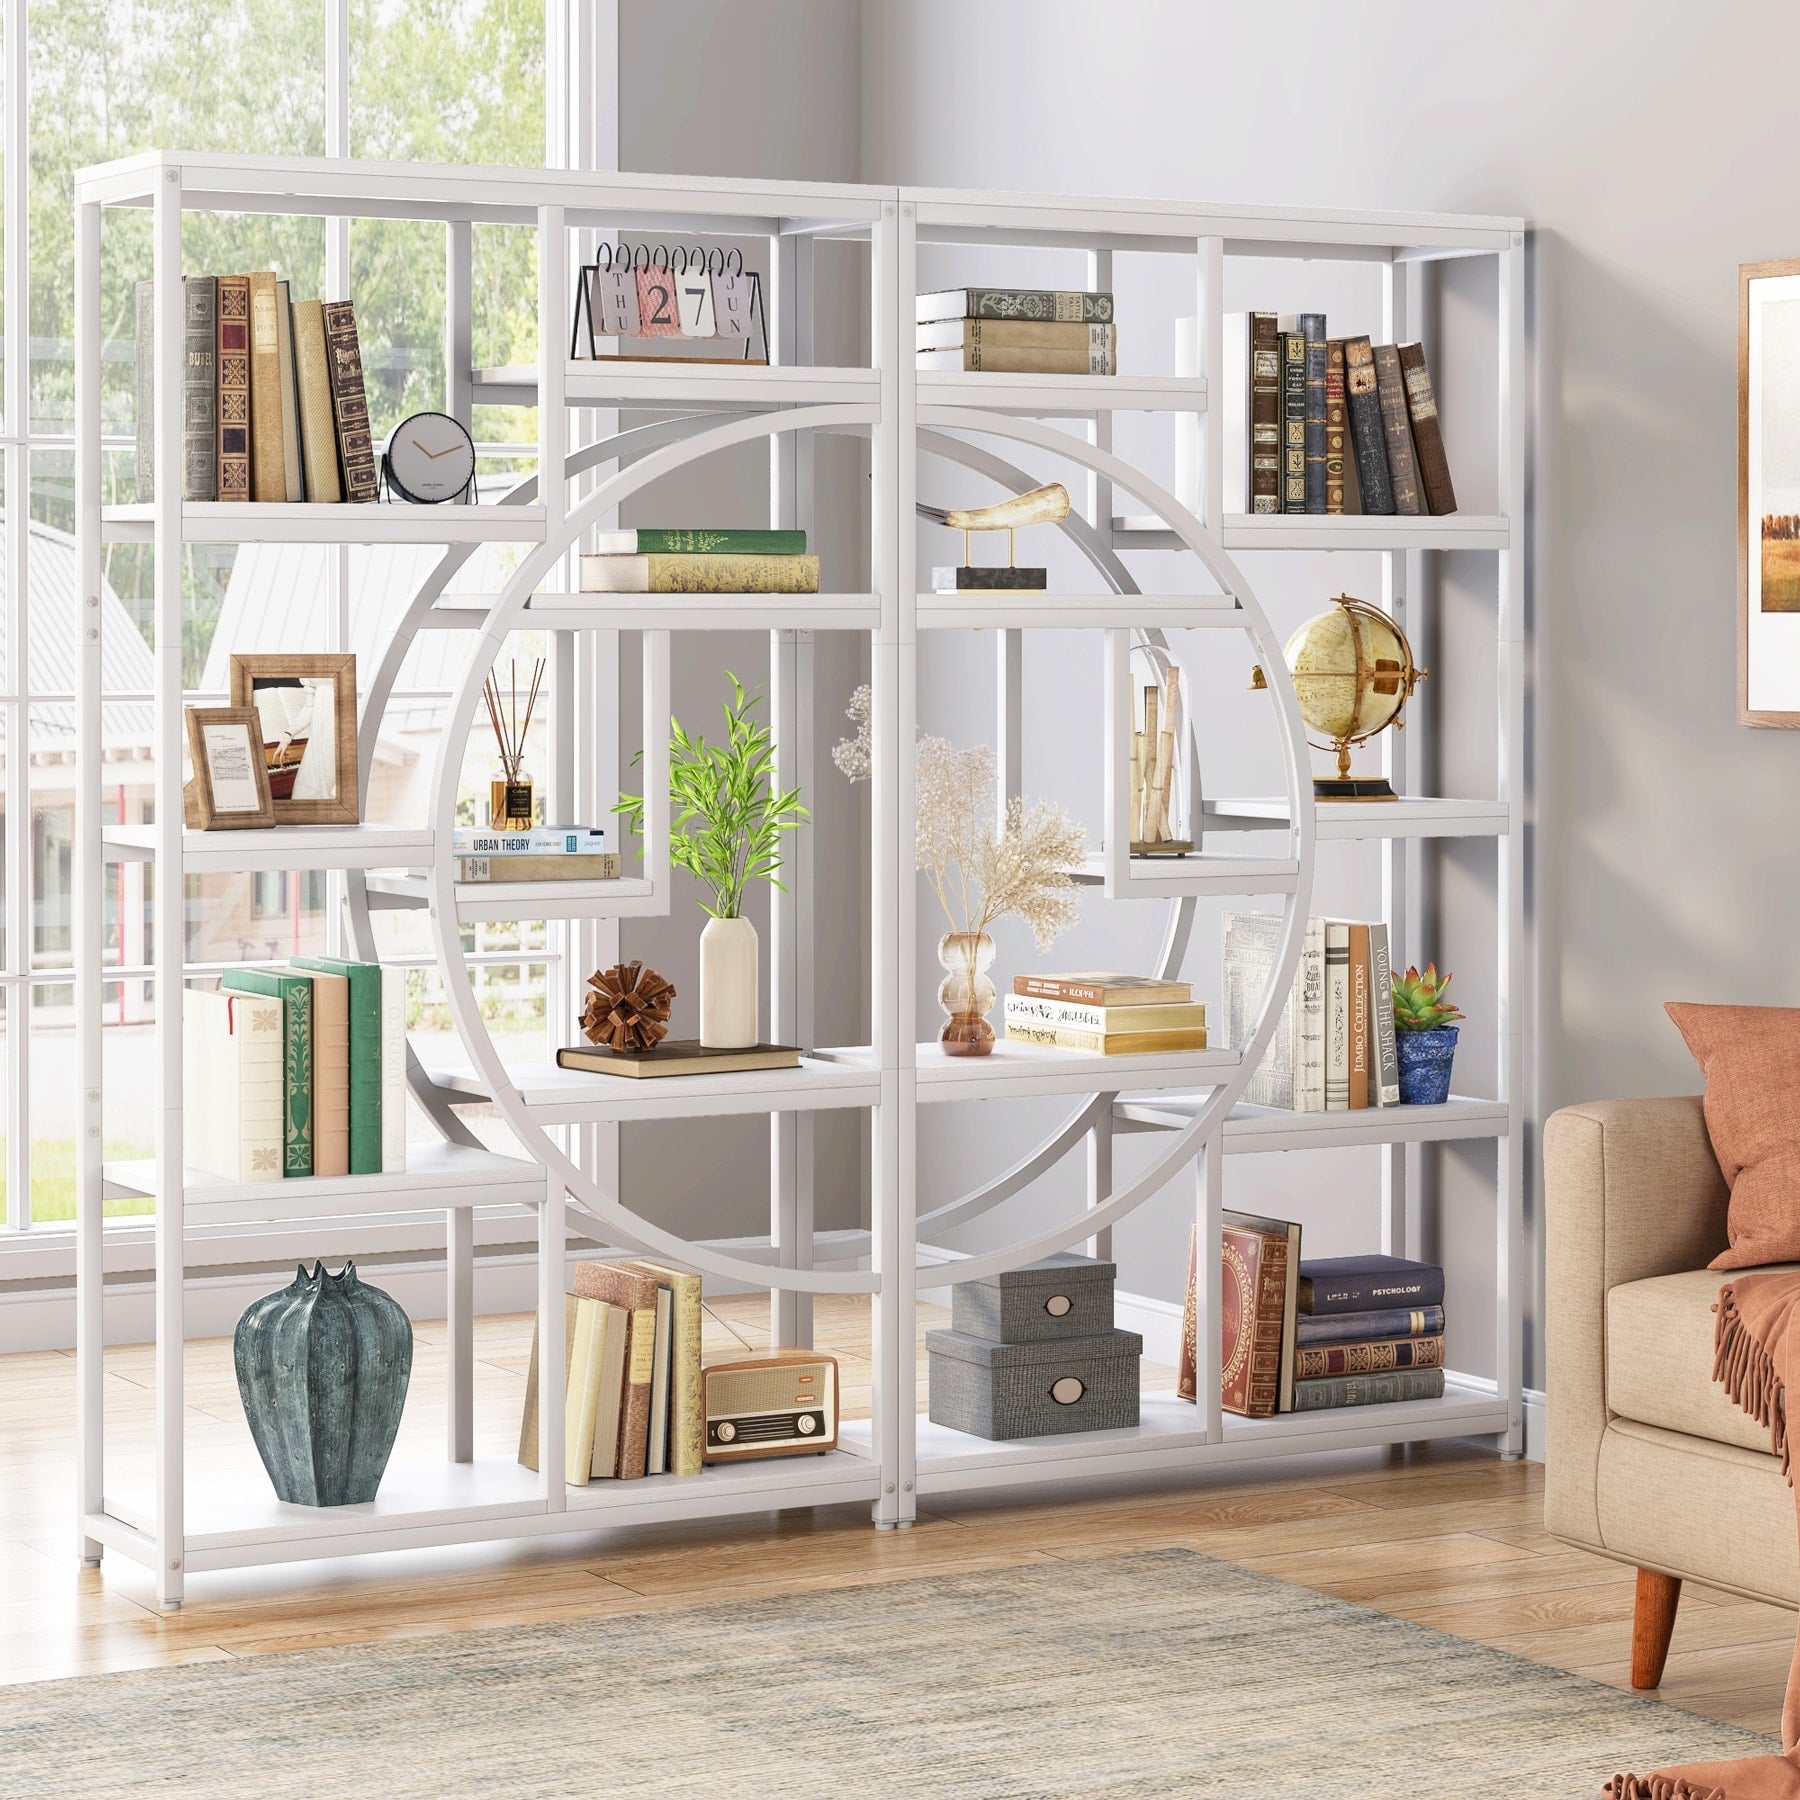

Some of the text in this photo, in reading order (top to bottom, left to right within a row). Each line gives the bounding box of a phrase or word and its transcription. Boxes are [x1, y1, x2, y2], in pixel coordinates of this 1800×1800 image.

[612, 272, 629, 331] THU
[726, 276, 742, 333] JUN
[473, 839, 499, 851] URBAN
[502, 838, 530, 851] THEORY
[1376, 944, 1389, 991] YOUNG
[1353, 964, 1366, 1073] JUMBO COLLECTION
[1378, 1002, 1396, 1072] THE SHACK
[1372, 1285, 1421, 1297] PSYCHOLOGY
